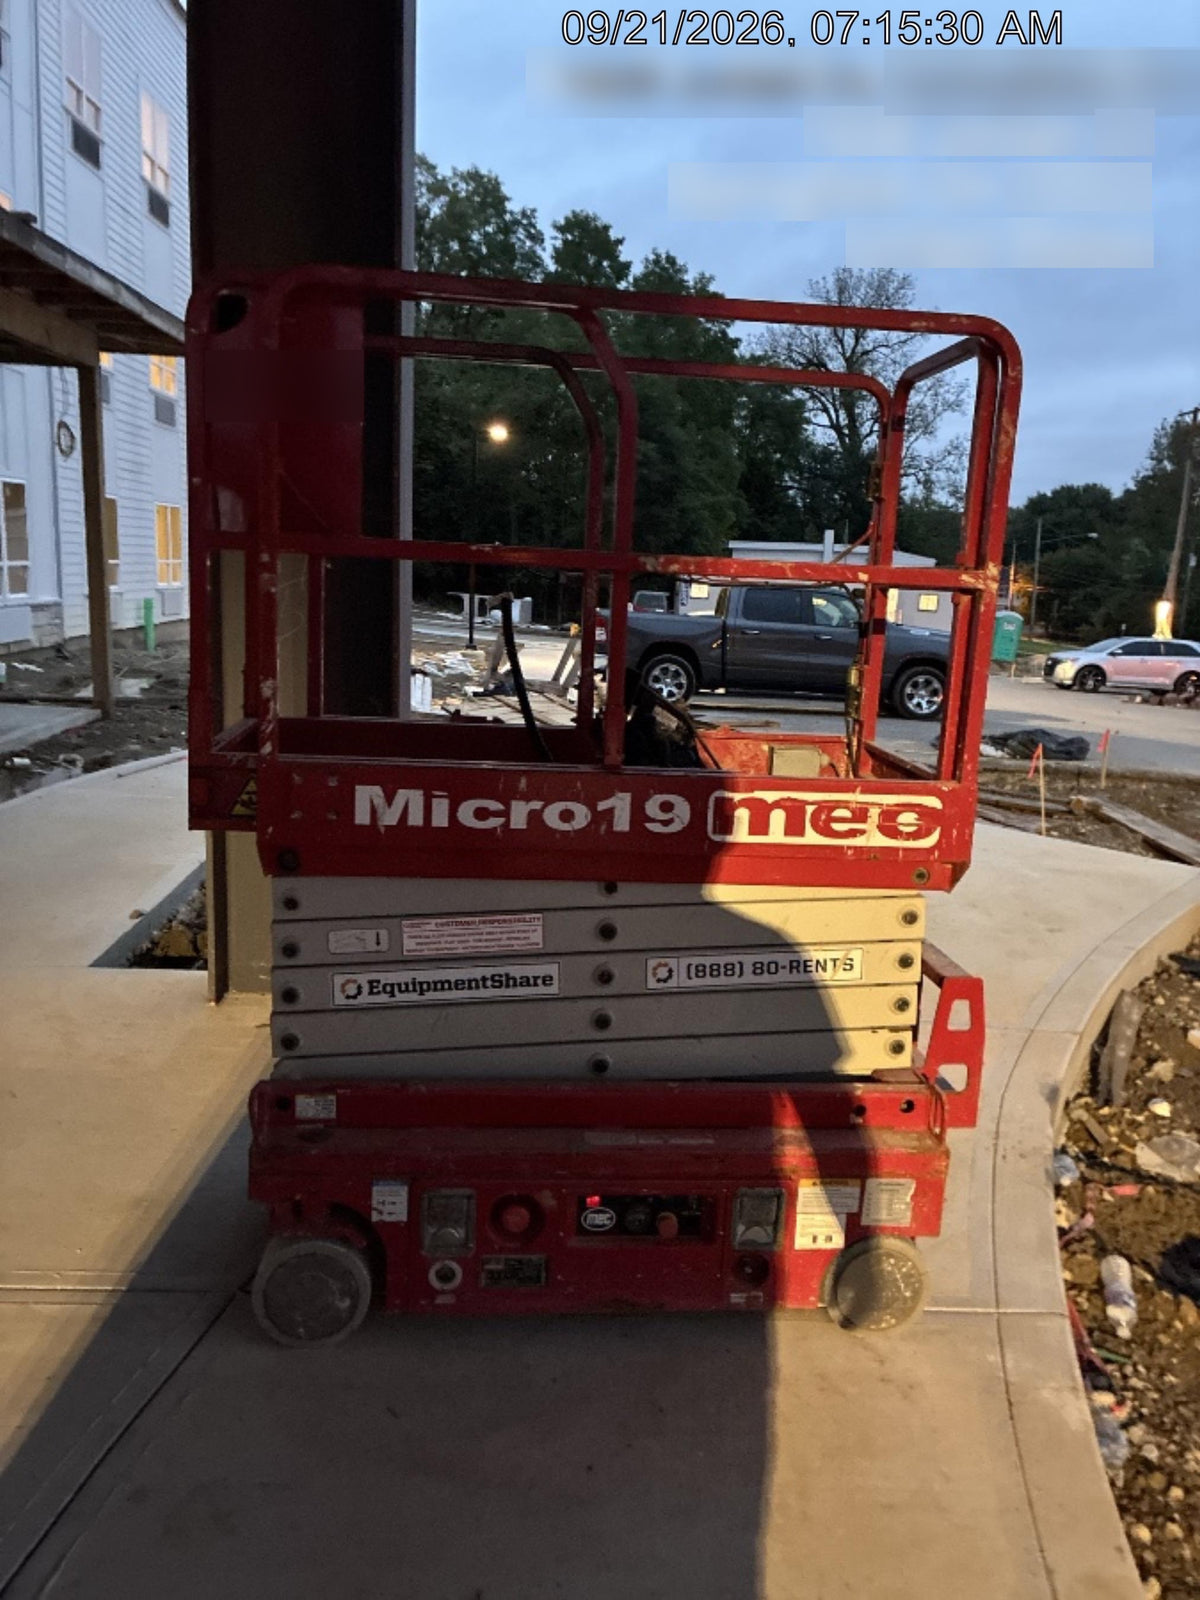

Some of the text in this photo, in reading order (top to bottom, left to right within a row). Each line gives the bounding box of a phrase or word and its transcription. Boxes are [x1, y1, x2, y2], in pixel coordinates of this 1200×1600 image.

[354, 785, 691, 833] Micro19
[686, 957, 854, 980] (888) 80-RENTS
[367, 972, 554, 998] EquipmentShare
